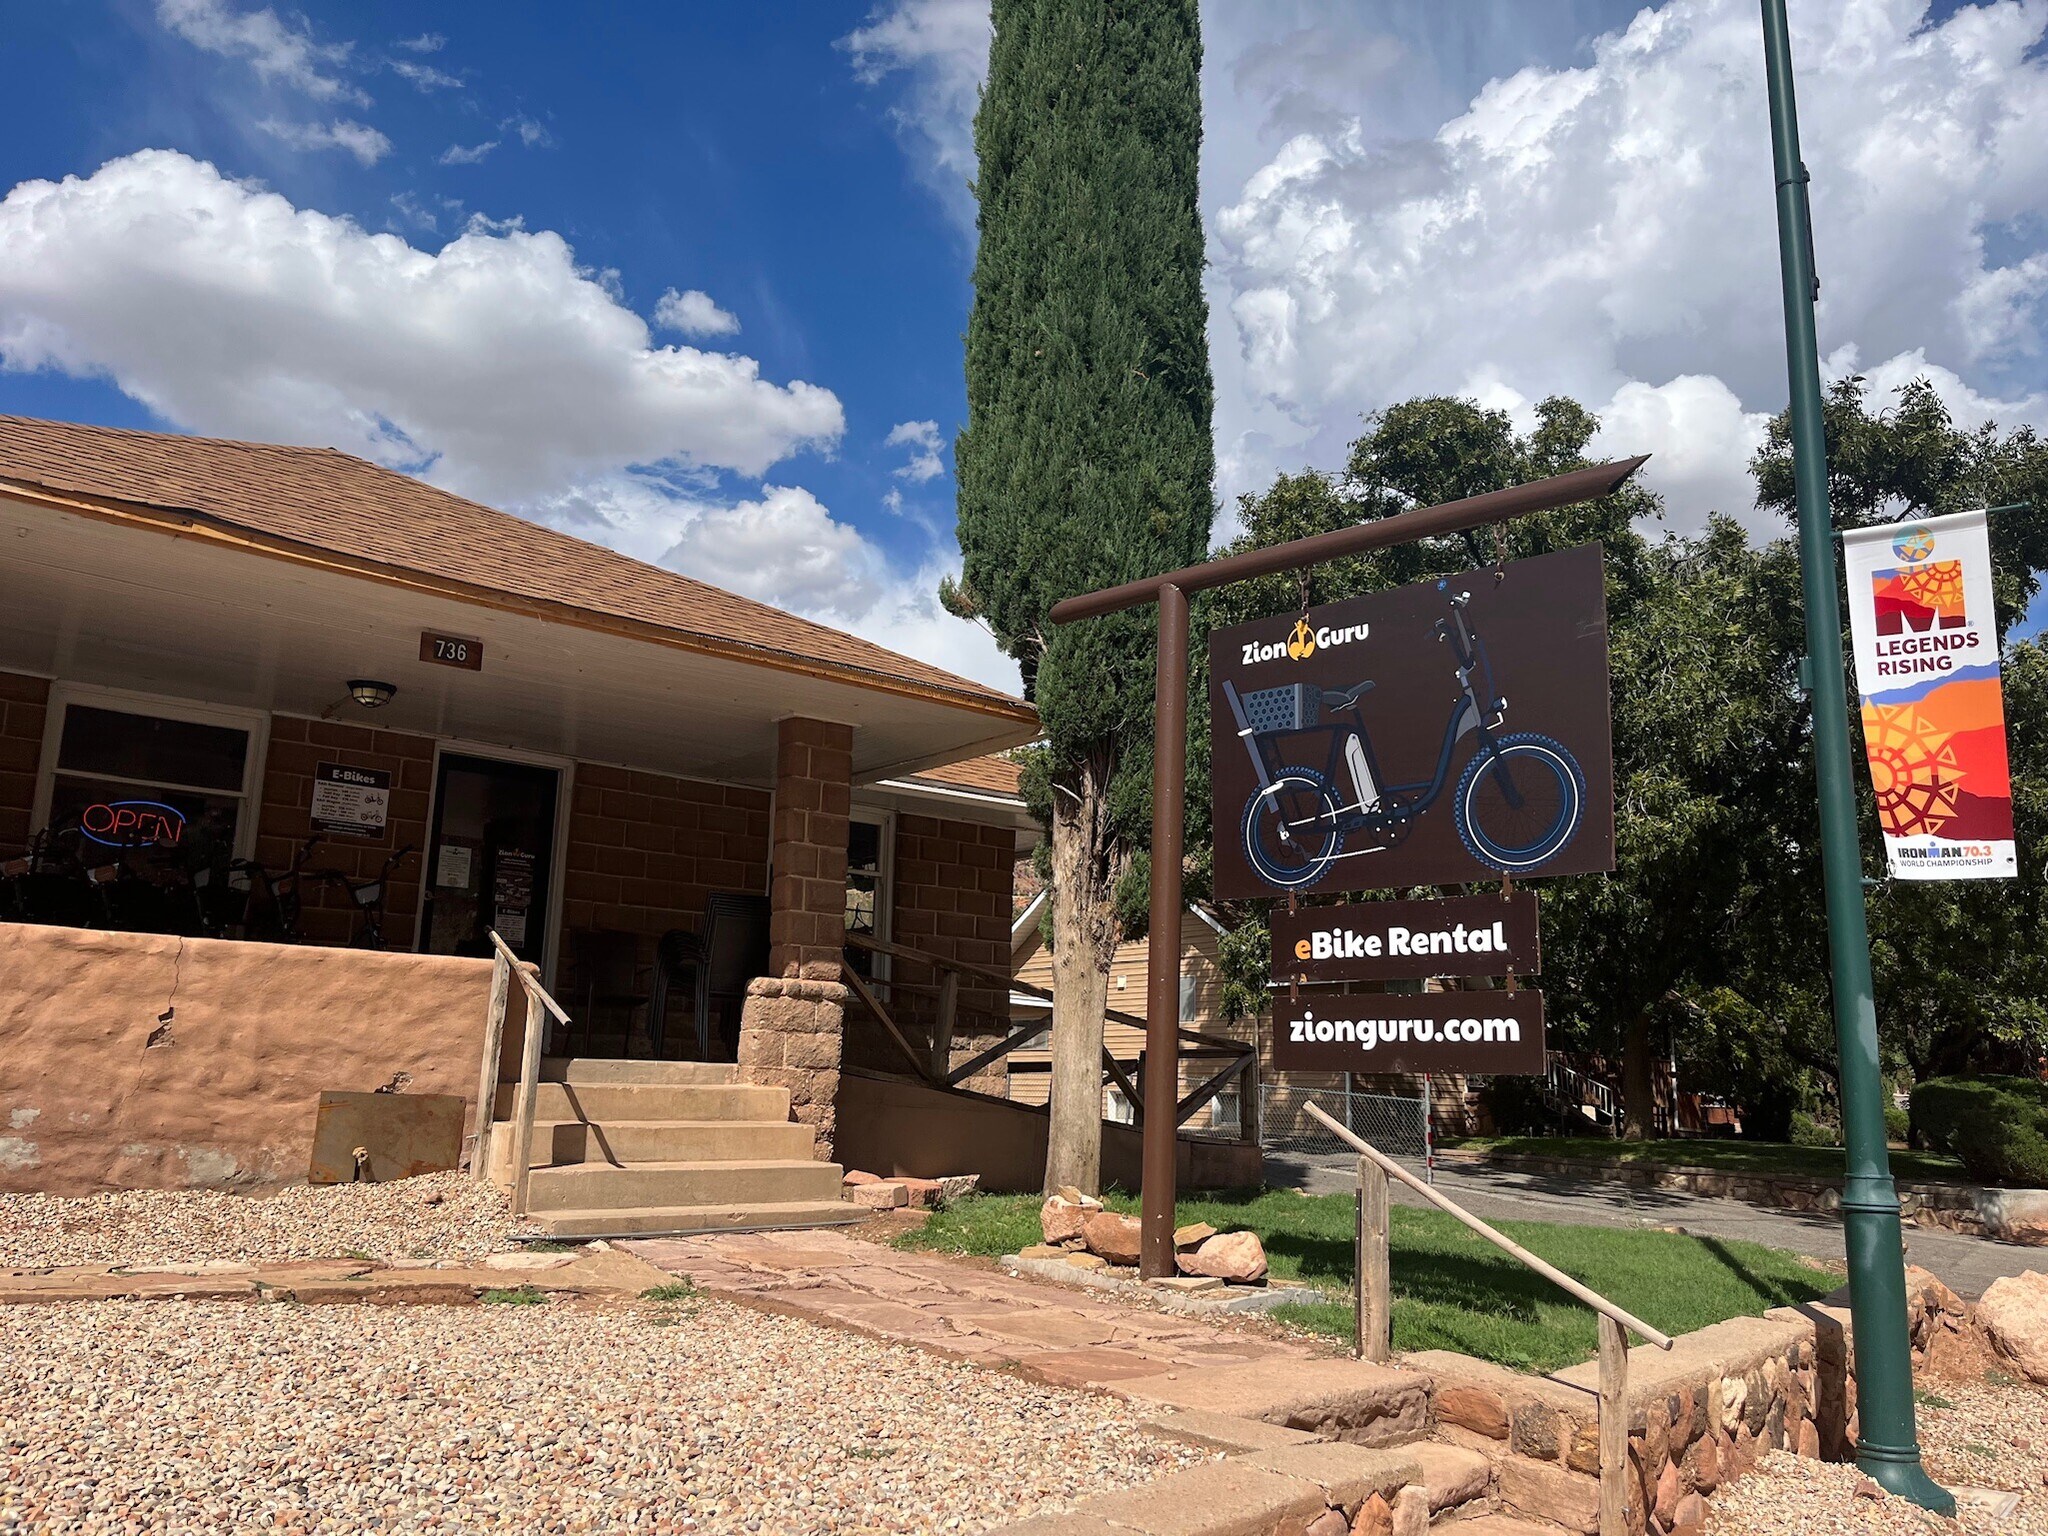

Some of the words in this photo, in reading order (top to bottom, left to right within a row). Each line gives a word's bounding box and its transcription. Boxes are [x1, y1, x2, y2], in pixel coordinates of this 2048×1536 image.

[435, 639, 467, 661] 736
[1242, 640, 1288, 665] Zion
[1315, 623, 1369, 649] Guru
[1876, 632, 1980, 657] LEGENDS
[1877, 655, 1952, 676] RISING
[332, 769, 376, 784] E-Bikes
[83, 804, 182, 843] OPEN
[1897, 845, 1962, 858] IRONMAN
[1963, 845, 1992, 857] 70.3
[1926, 858, 1993, 867] CHAMPIONSHIP
[1294, 927, 1383, 960] eBike
[1388, 920, 1508, 957] Rental
[1289, 1010, 1521, 1051] zionguru.com
